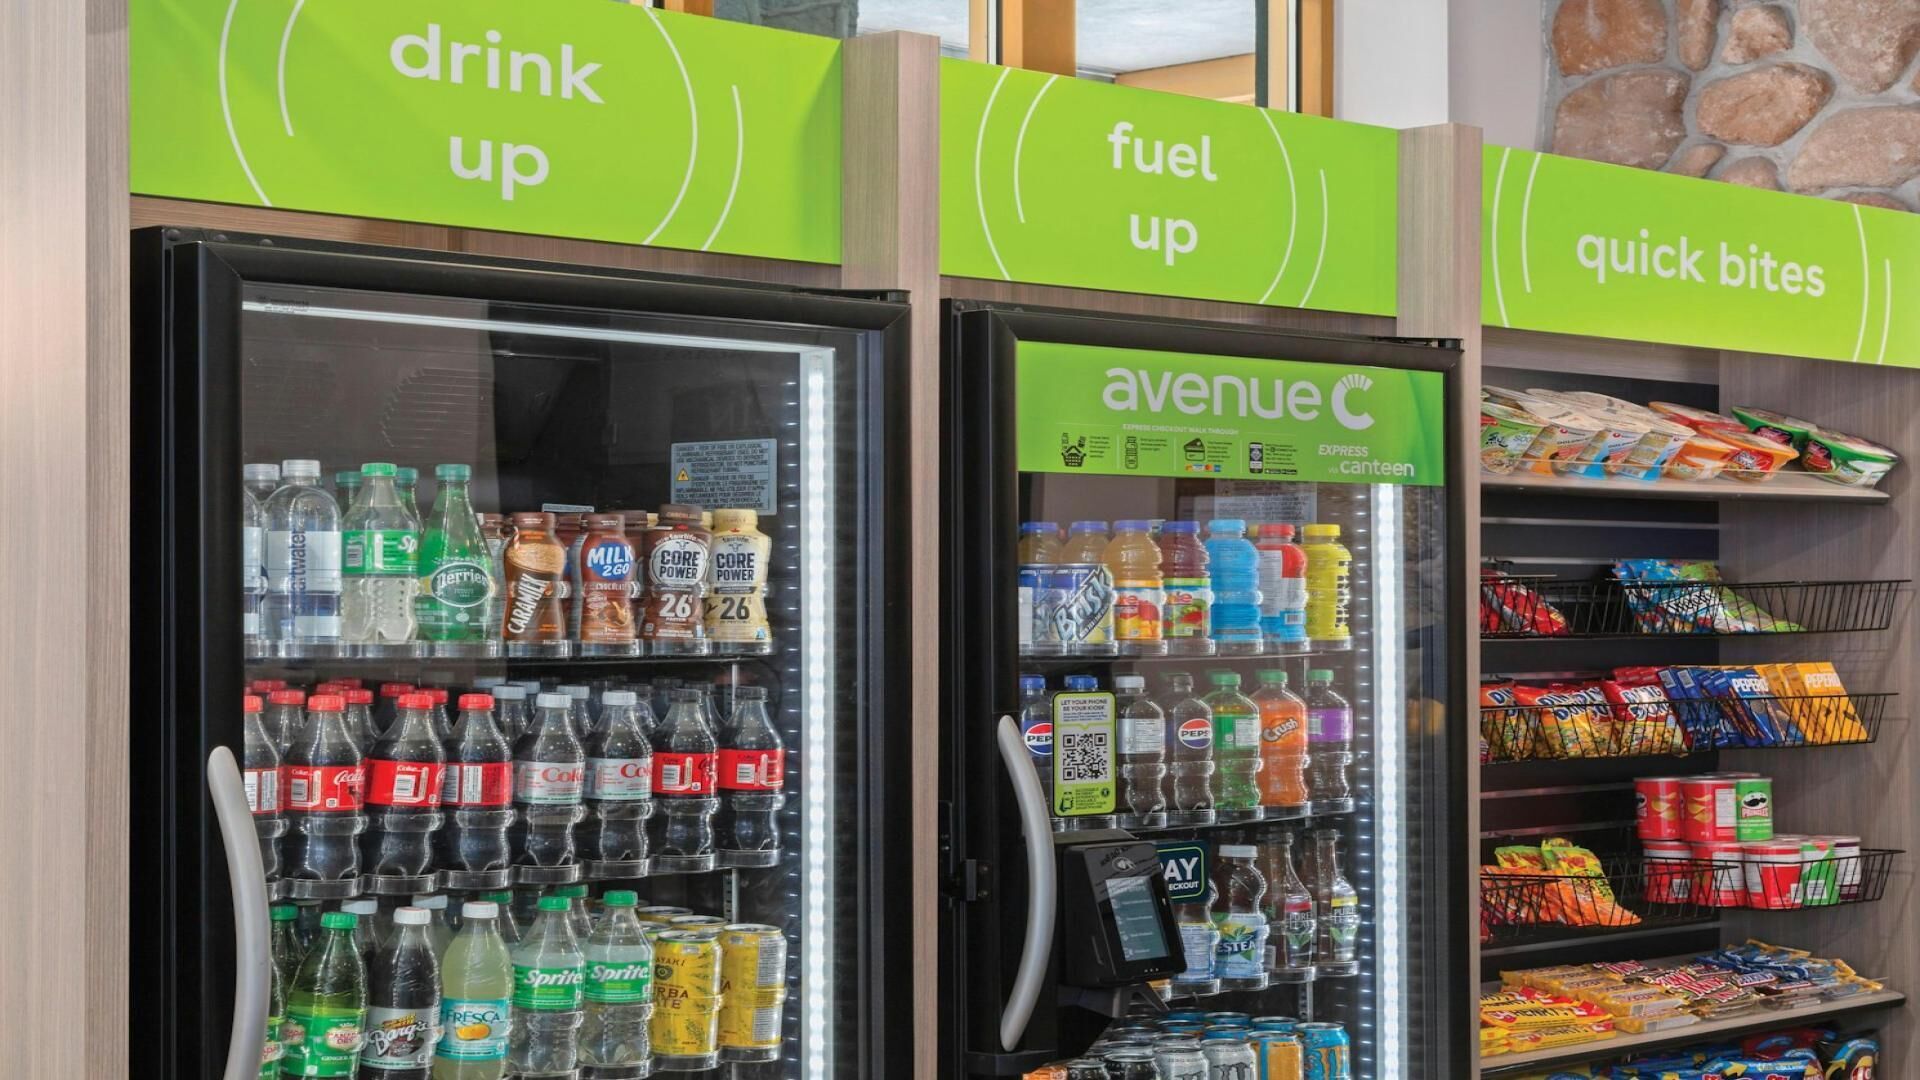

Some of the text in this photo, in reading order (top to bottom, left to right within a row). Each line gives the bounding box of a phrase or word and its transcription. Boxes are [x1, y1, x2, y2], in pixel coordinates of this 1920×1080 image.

[389, 23, 604, 104] drink
[1107, 120, 1218, 183] fuel
[449, 135, 550, 201] up
[1130, 214, 1198, 266] up
[1576, 233, 1826, 299] quick bites
[1102, 367, 1322, 421] avenue
[1318, 444, 1369, 458] EXPRESS
[1340, 459, 1415, 478] canteen
[587, 544, 634, 568] MILK
[660, 549, 701, 567] CORE
[716, 552, 756, 569] CORE
[602, 563, 630, 577] 2GO
[659, 566, 699, 580] POWER
[717, 569, 755, 581] POWER
[507, 573, 550, 635] CARAMILK
[1261, 717, 1300, 742] Crush
[1160, 856, 1199, 882] AY
[523, 968, 583, 988] Sprite
[590, 964, 650, 983] Sprite
[654, 986, 689, 999] RBA
[446, 1009, 501, 1026] FRESCA
[369, 1020, 430, 1058] Barq's
